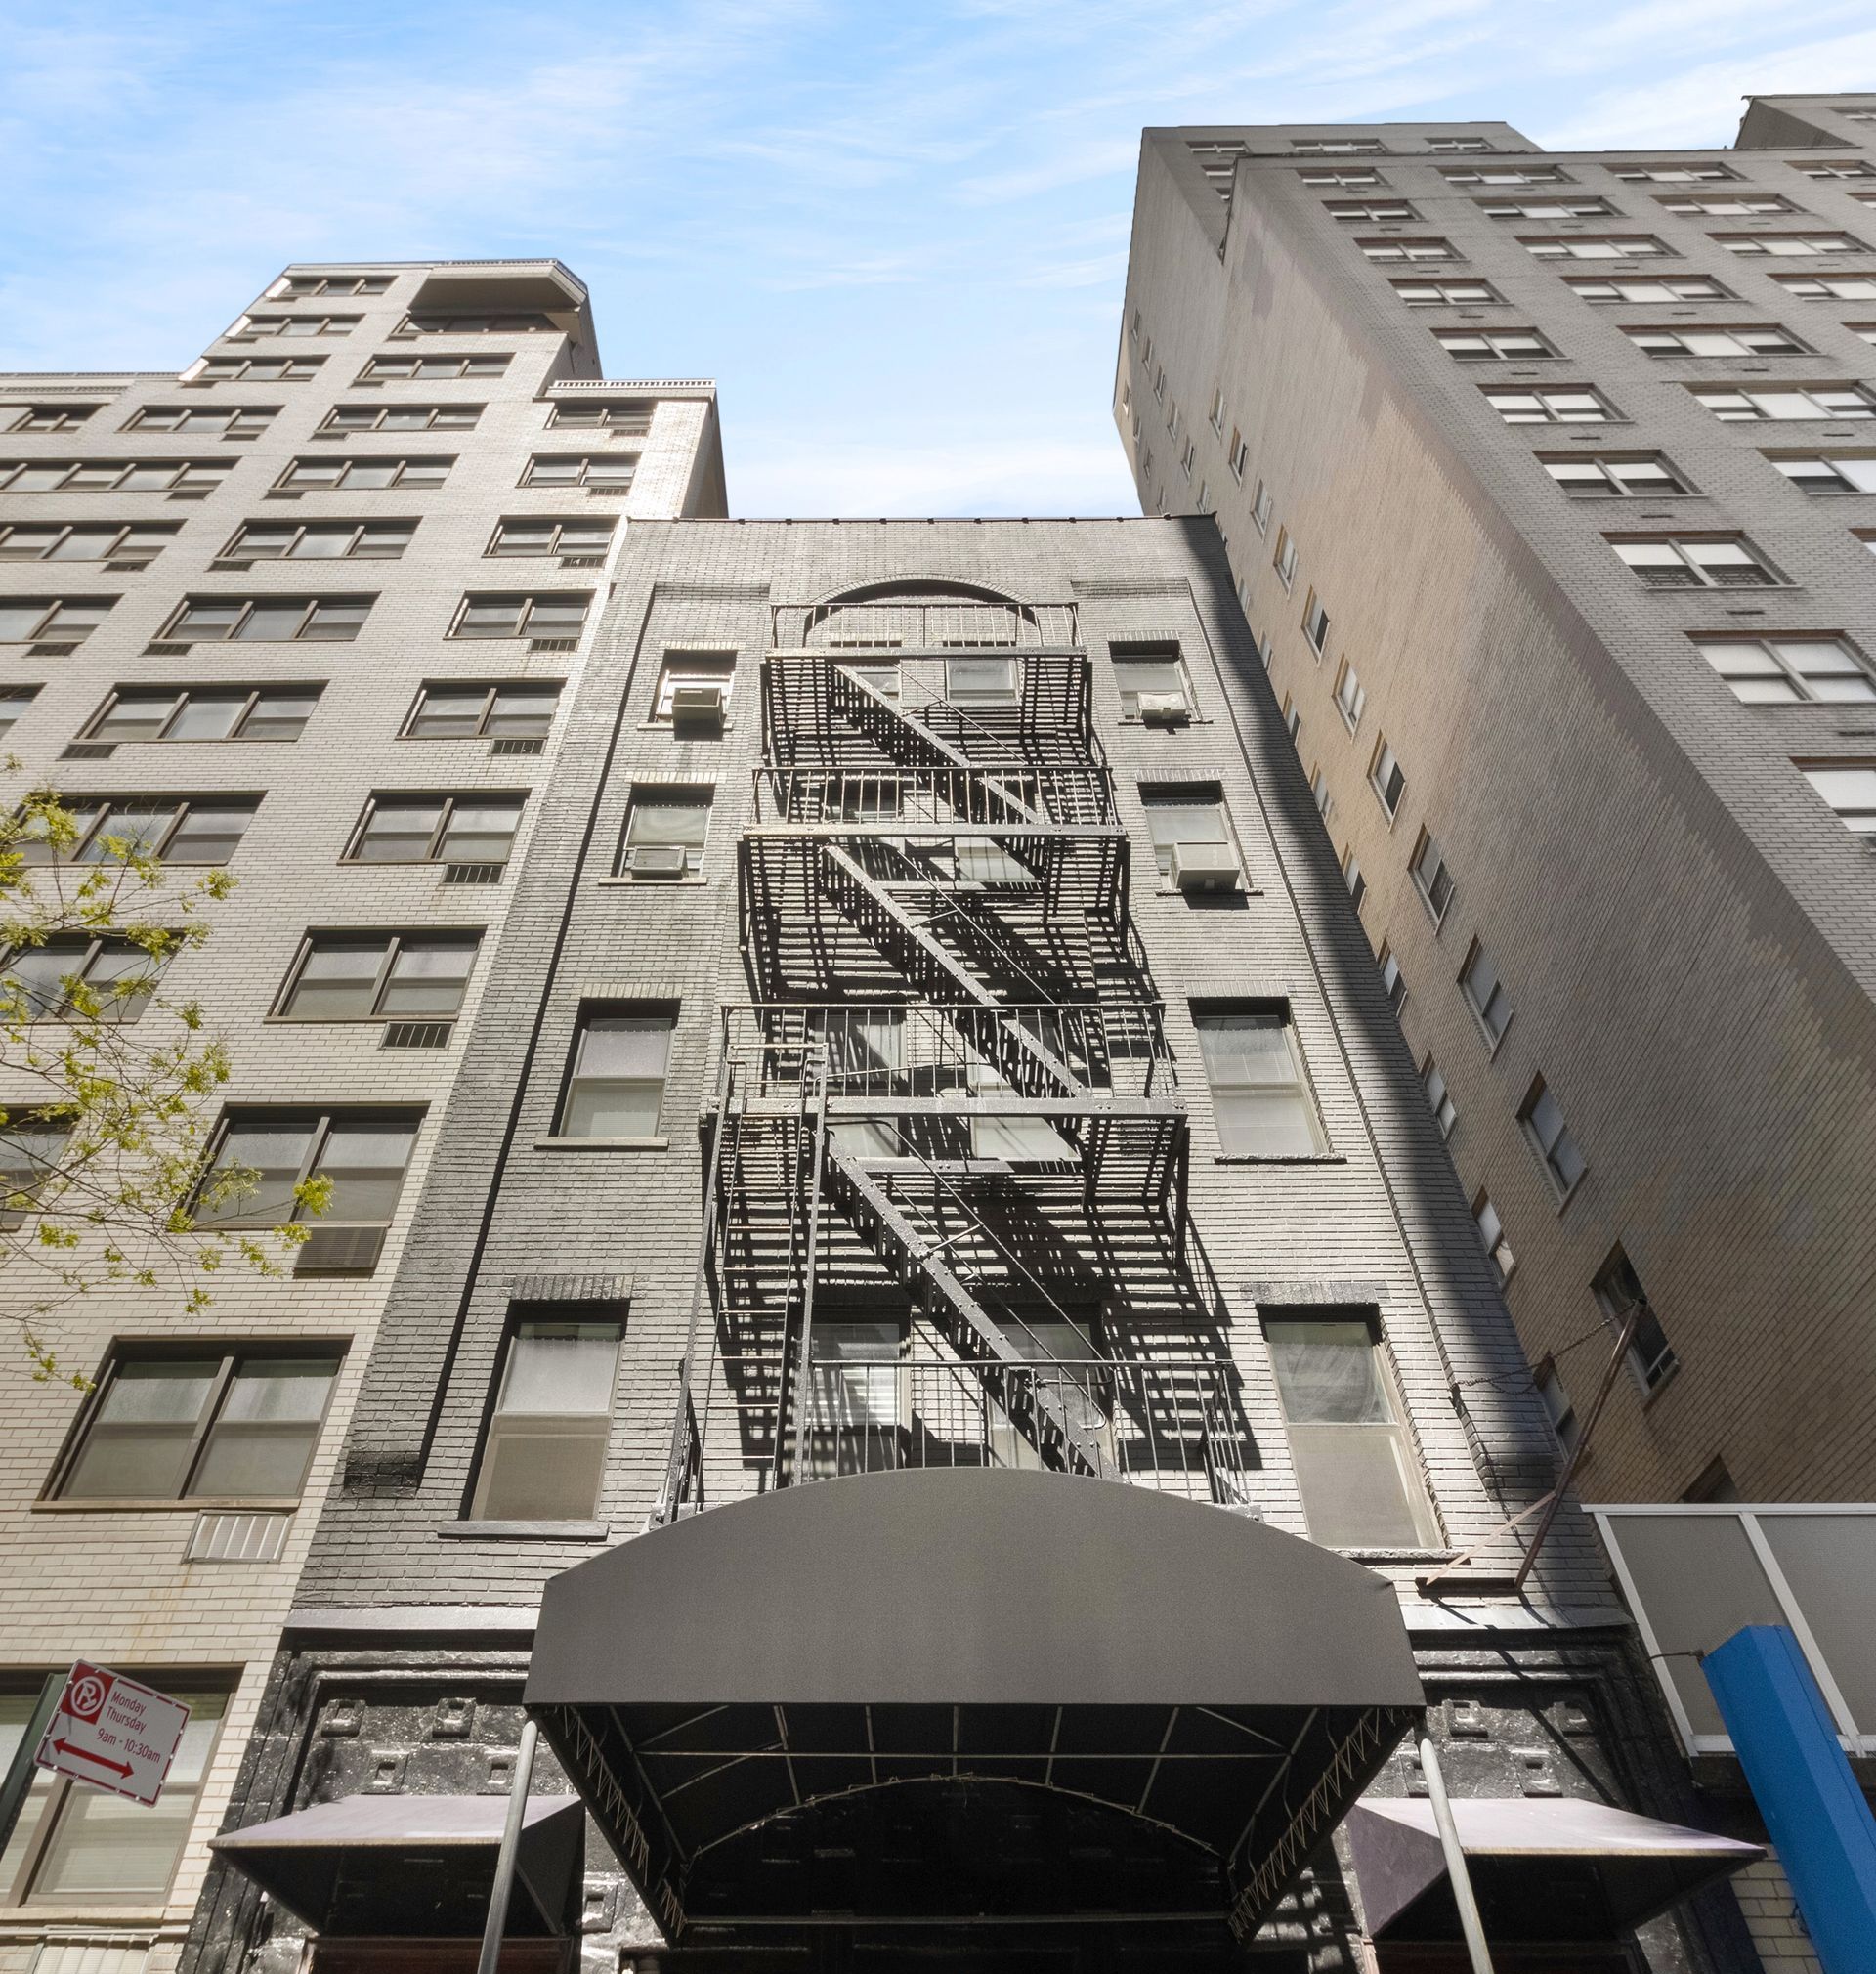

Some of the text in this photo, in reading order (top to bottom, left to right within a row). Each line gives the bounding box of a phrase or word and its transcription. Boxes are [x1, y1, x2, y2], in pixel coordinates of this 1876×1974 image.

[110, 1691, 147, 1714] Monday
[106, 1706, 147, 1735] Thursday
[96, 1728, 117, 1746] 9am
[124, 1738, 161, 1763] 10:30am
